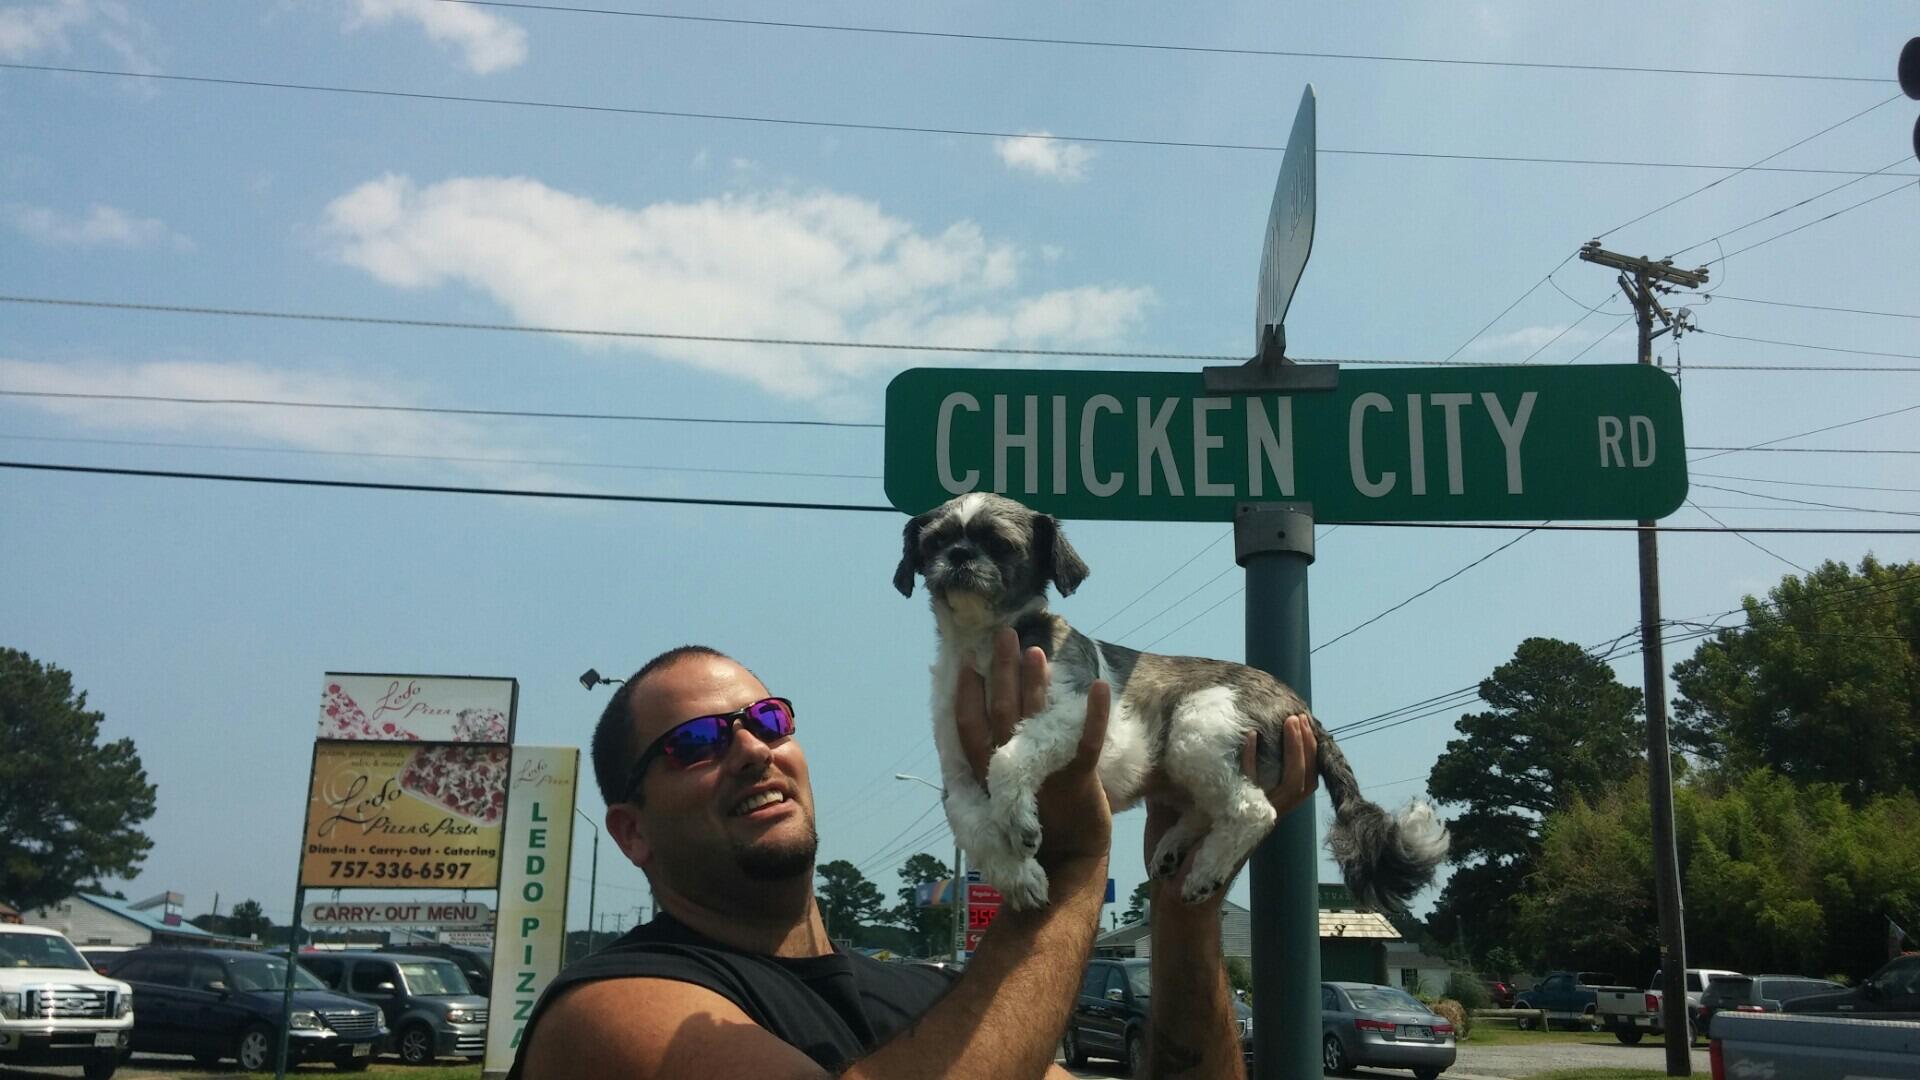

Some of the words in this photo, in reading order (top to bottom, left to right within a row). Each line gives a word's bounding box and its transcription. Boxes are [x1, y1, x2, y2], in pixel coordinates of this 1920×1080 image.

[935, 391, 1295, 498] CHICKEN
[1347, 391, 1538, 498] CITY
[1599, 415, 1657, 468] RD
[318, 775, 402, 837] Ledo
[308, 844, 357, 854] Dine-In
[369, 845, 432, 857] Carry-Out
[443, 846, 496, 858] Catering
[329, 861, 472, 880] 757-336-6597
[522, 802, 548, 902] LEDO
[427, 906, 477, 921] MENU
